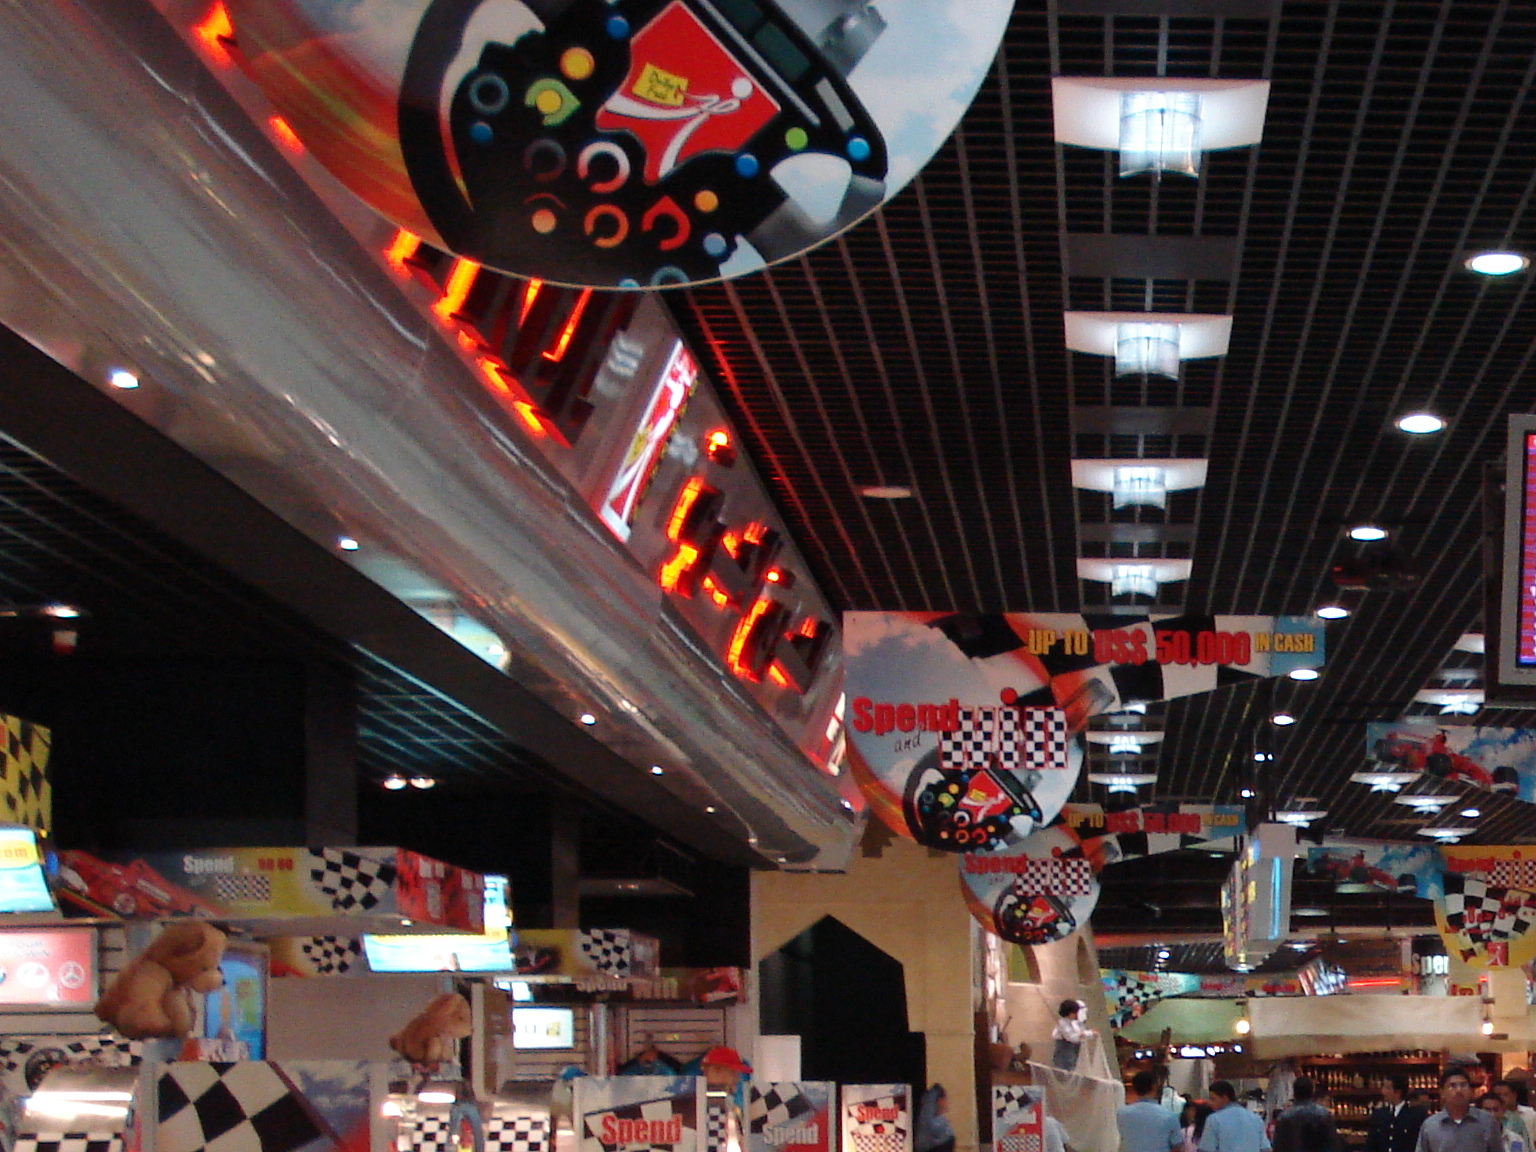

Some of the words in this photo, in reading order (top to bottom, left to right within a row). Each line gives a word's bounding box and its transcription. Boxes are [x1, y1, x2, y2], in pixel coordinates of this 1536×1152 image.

[1028, 630, 1055, 655] UP
[1063, 630, 1088, 655] TO
[1254, 633, 1270, 651] IN
[1273, 633, 1314, 652] CASH
[852, 696, 959, 735] Spend
[602, 1113, 683, 1146] Spend
